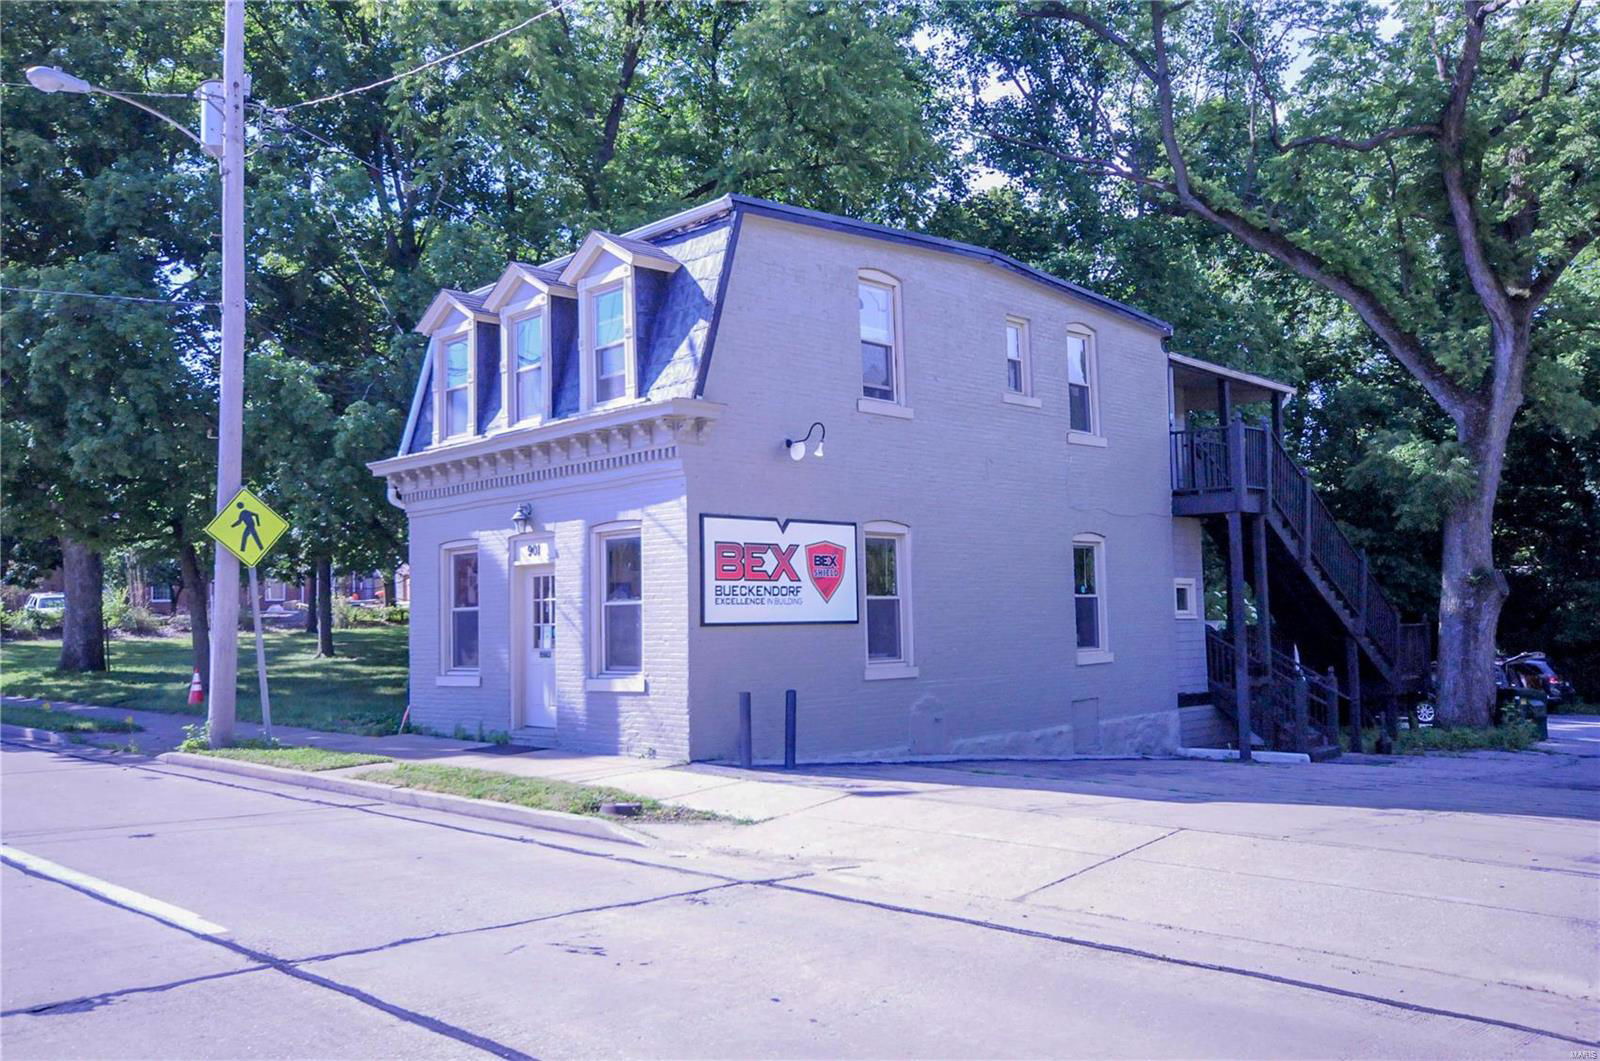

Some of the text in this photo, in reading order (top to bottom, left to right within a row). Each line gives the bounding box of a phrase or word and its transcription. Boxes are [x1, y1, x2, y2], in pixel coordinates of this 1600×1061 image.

[527, 544, 541, 557] 901
[714, 541, 801, 582] BEX
[814, 555, 837, 567] BEX
[814, 569, 839, 577] SHIELD
[714, 585, 802, 597] BUECKENDORF
